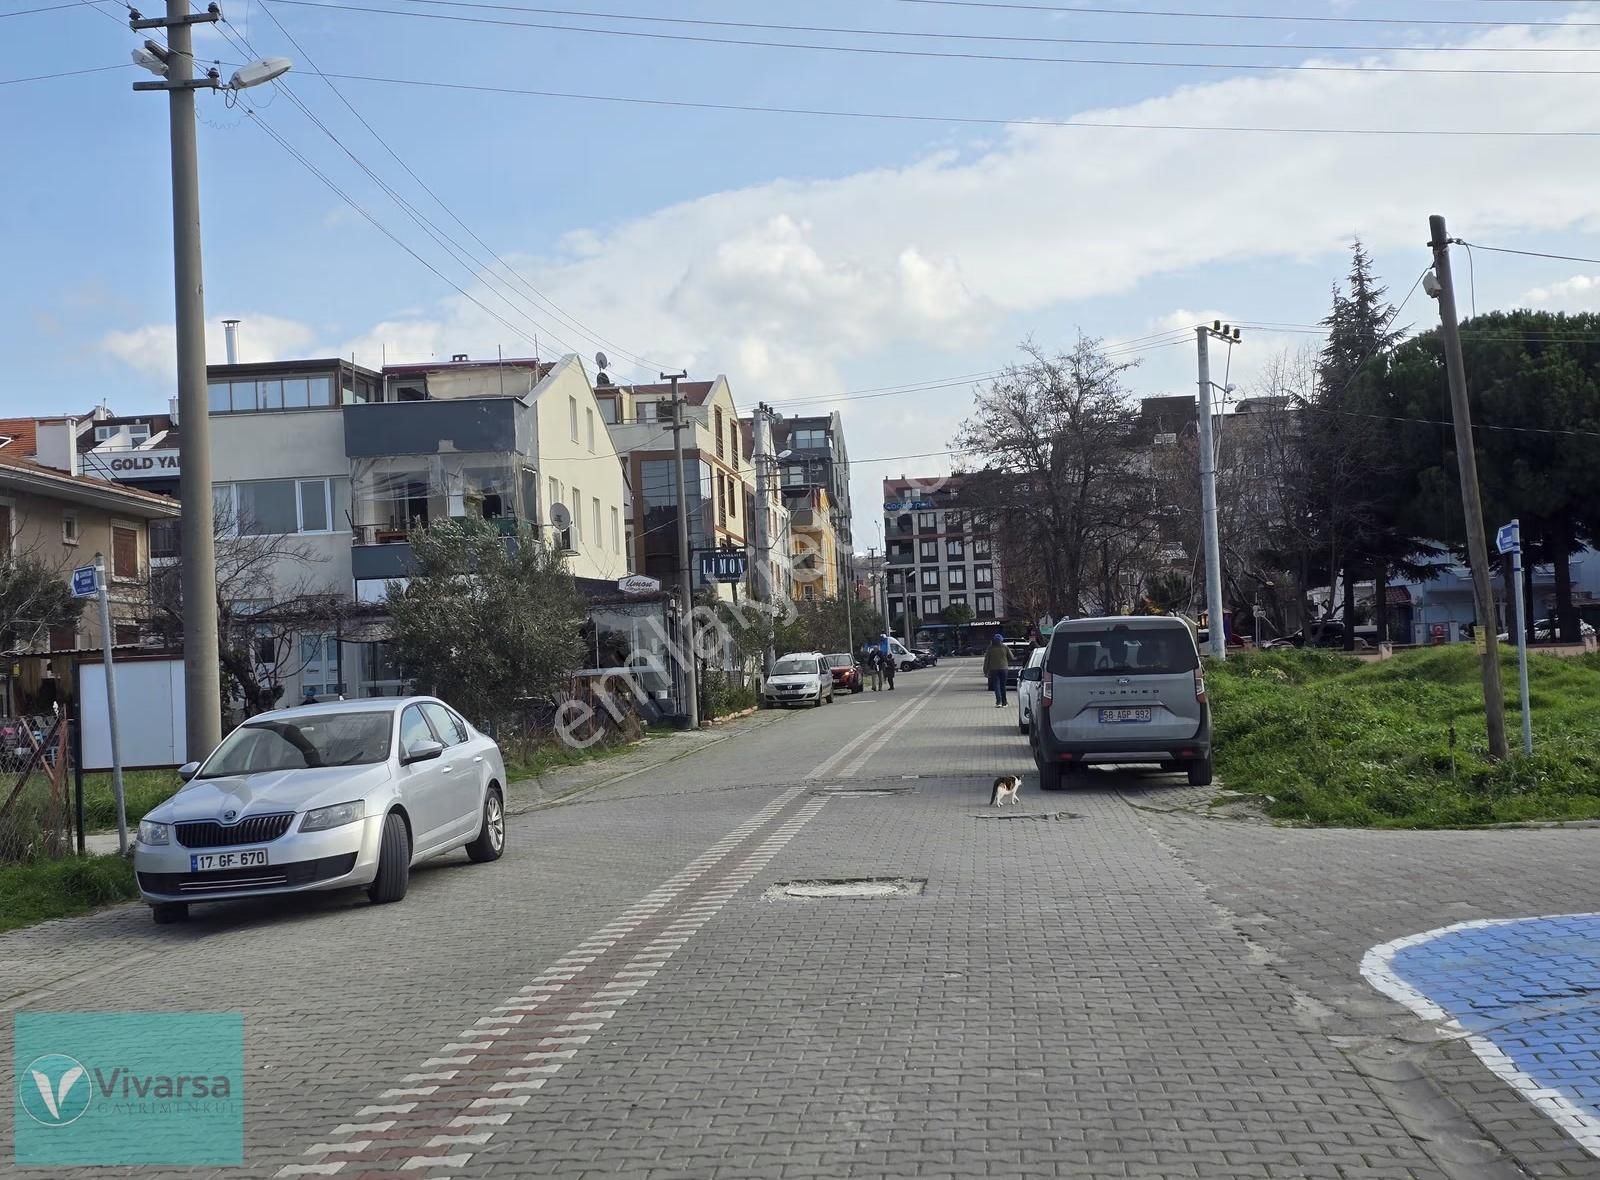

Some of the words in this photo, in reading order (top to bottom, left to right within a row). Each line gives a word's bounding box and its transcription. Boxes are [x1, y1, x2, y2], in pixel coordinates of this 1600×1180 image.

[111, 457, 153, 471] GOLD
[1117, 710, 1131, 719] AGP
[200, 856, 213, 868] 17
[219, 854, 234, 867] GF
[241, 852, 264, 865] 670
